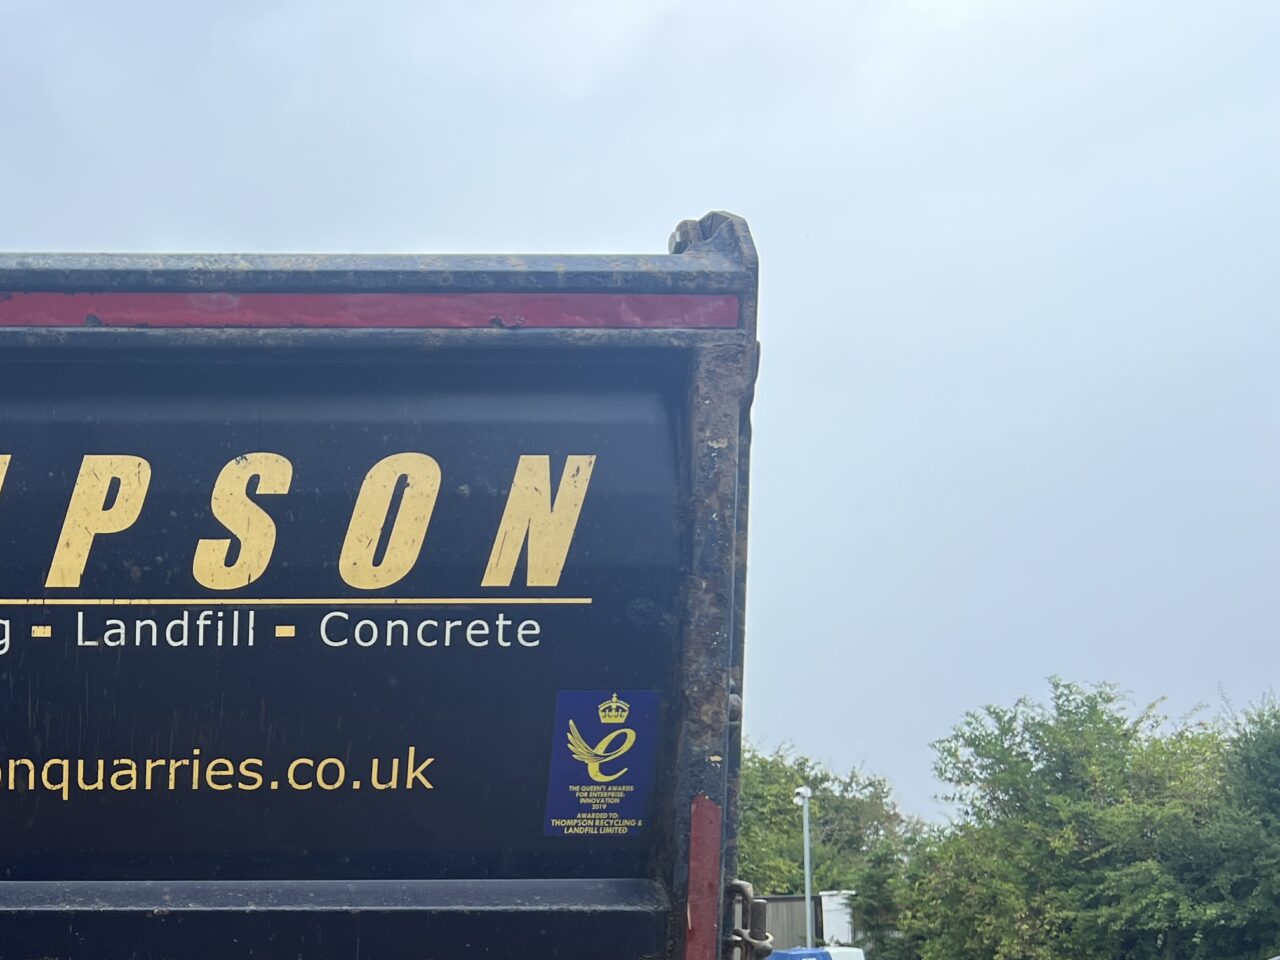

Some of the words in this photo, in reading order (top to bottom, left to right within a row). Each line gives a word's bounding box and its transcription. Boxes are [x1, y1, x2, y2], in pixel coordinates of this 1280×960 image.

[77, 610, 255, 647] Landfill
[320, 611, 541, 647] Concrete
[551, 819, 594, 827] THOMPSON
[595, 819, 636, 827] RECYCLING
[564, 826, 598, 834] LANDFILL
[599, 826, 628, 834] LIMITED
